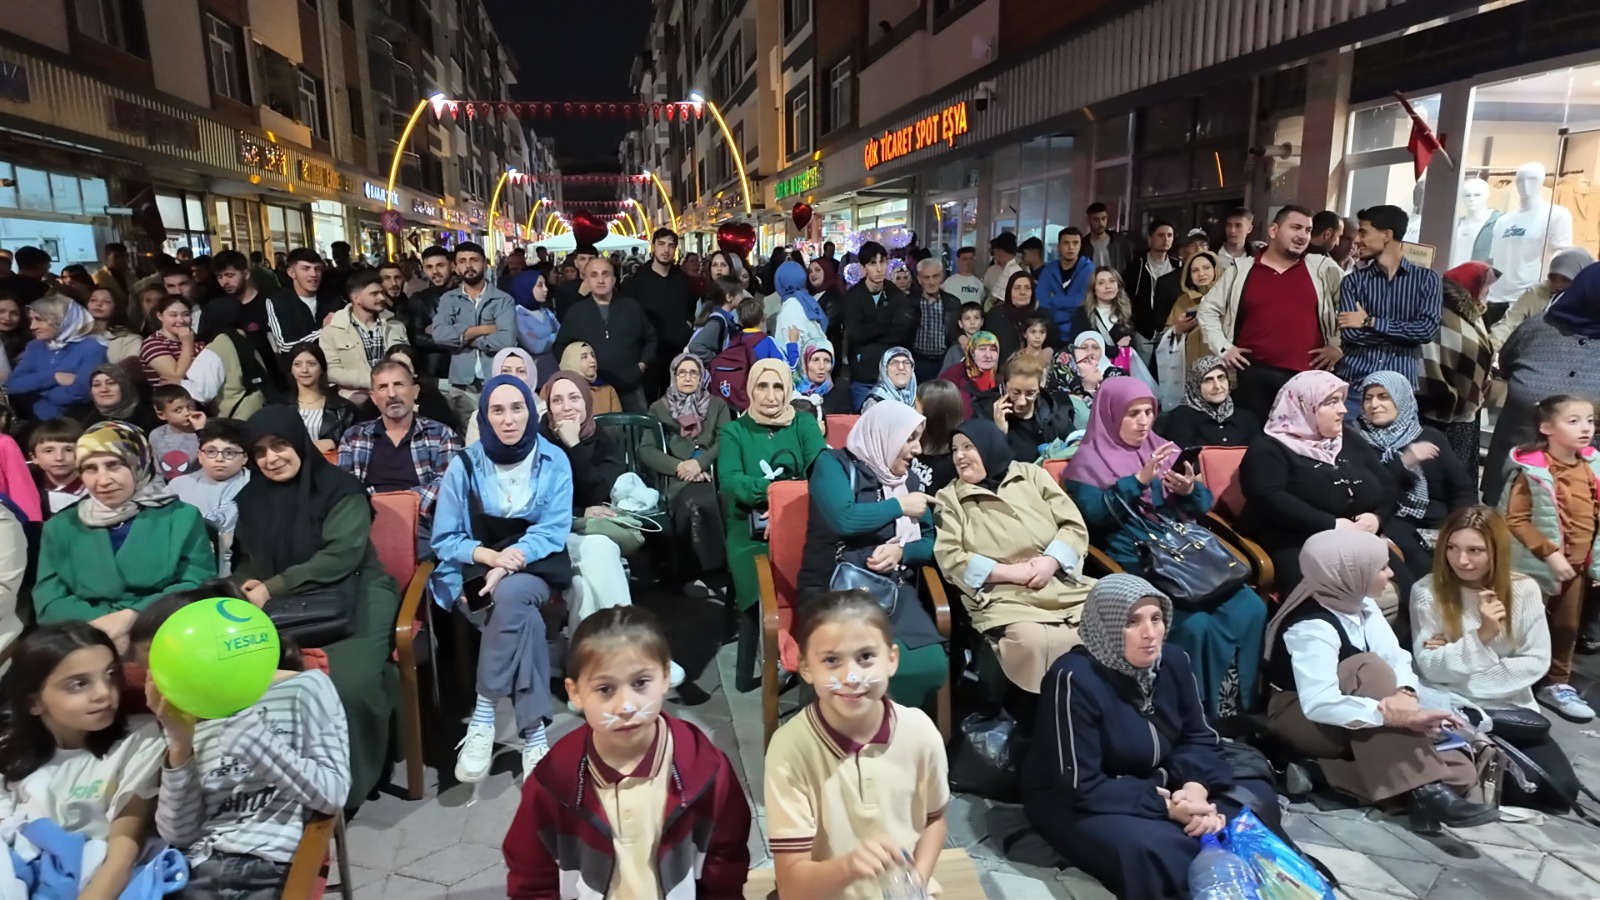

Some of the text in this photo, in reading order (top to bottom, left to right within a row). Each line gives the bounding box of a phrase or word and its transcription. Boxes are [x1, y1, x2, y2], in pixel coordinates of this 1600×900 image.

[880, 126, 913, 161] TİCARET
[915, 114, 939, 149] SPOT
[942, 101, 967, 147] EŞYA
